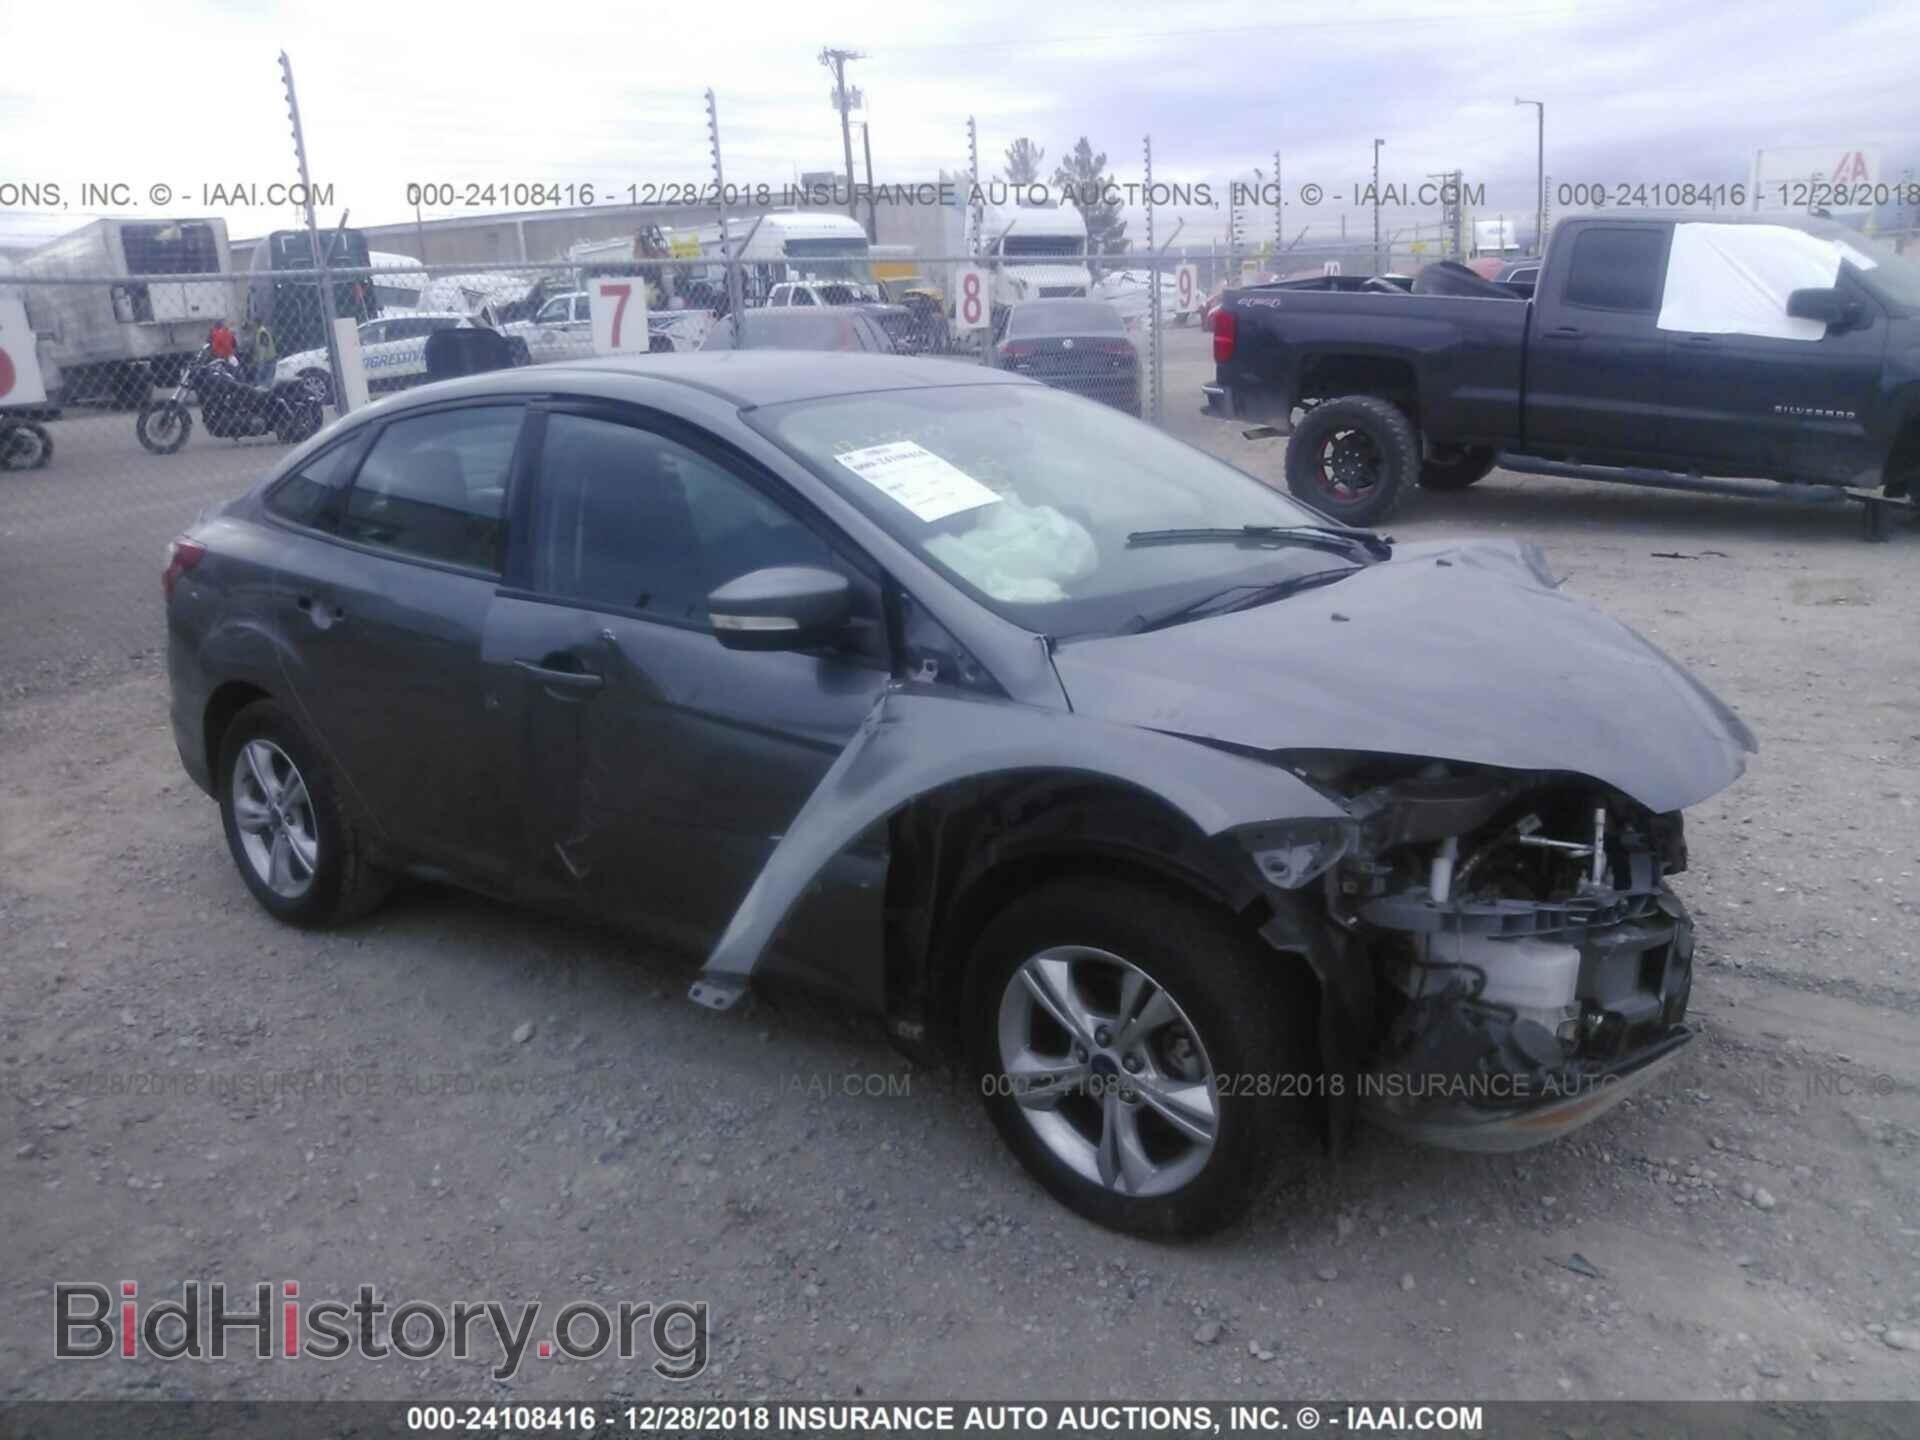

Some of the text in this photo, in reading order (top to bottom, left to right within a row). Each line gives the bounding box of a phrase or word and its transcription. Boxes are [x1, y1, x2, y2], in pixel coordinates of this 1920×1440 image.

[963, 273, 982, 324] 8
[1179, 268, 1192, 307] 9
[600, 284, 631, 348] 7
